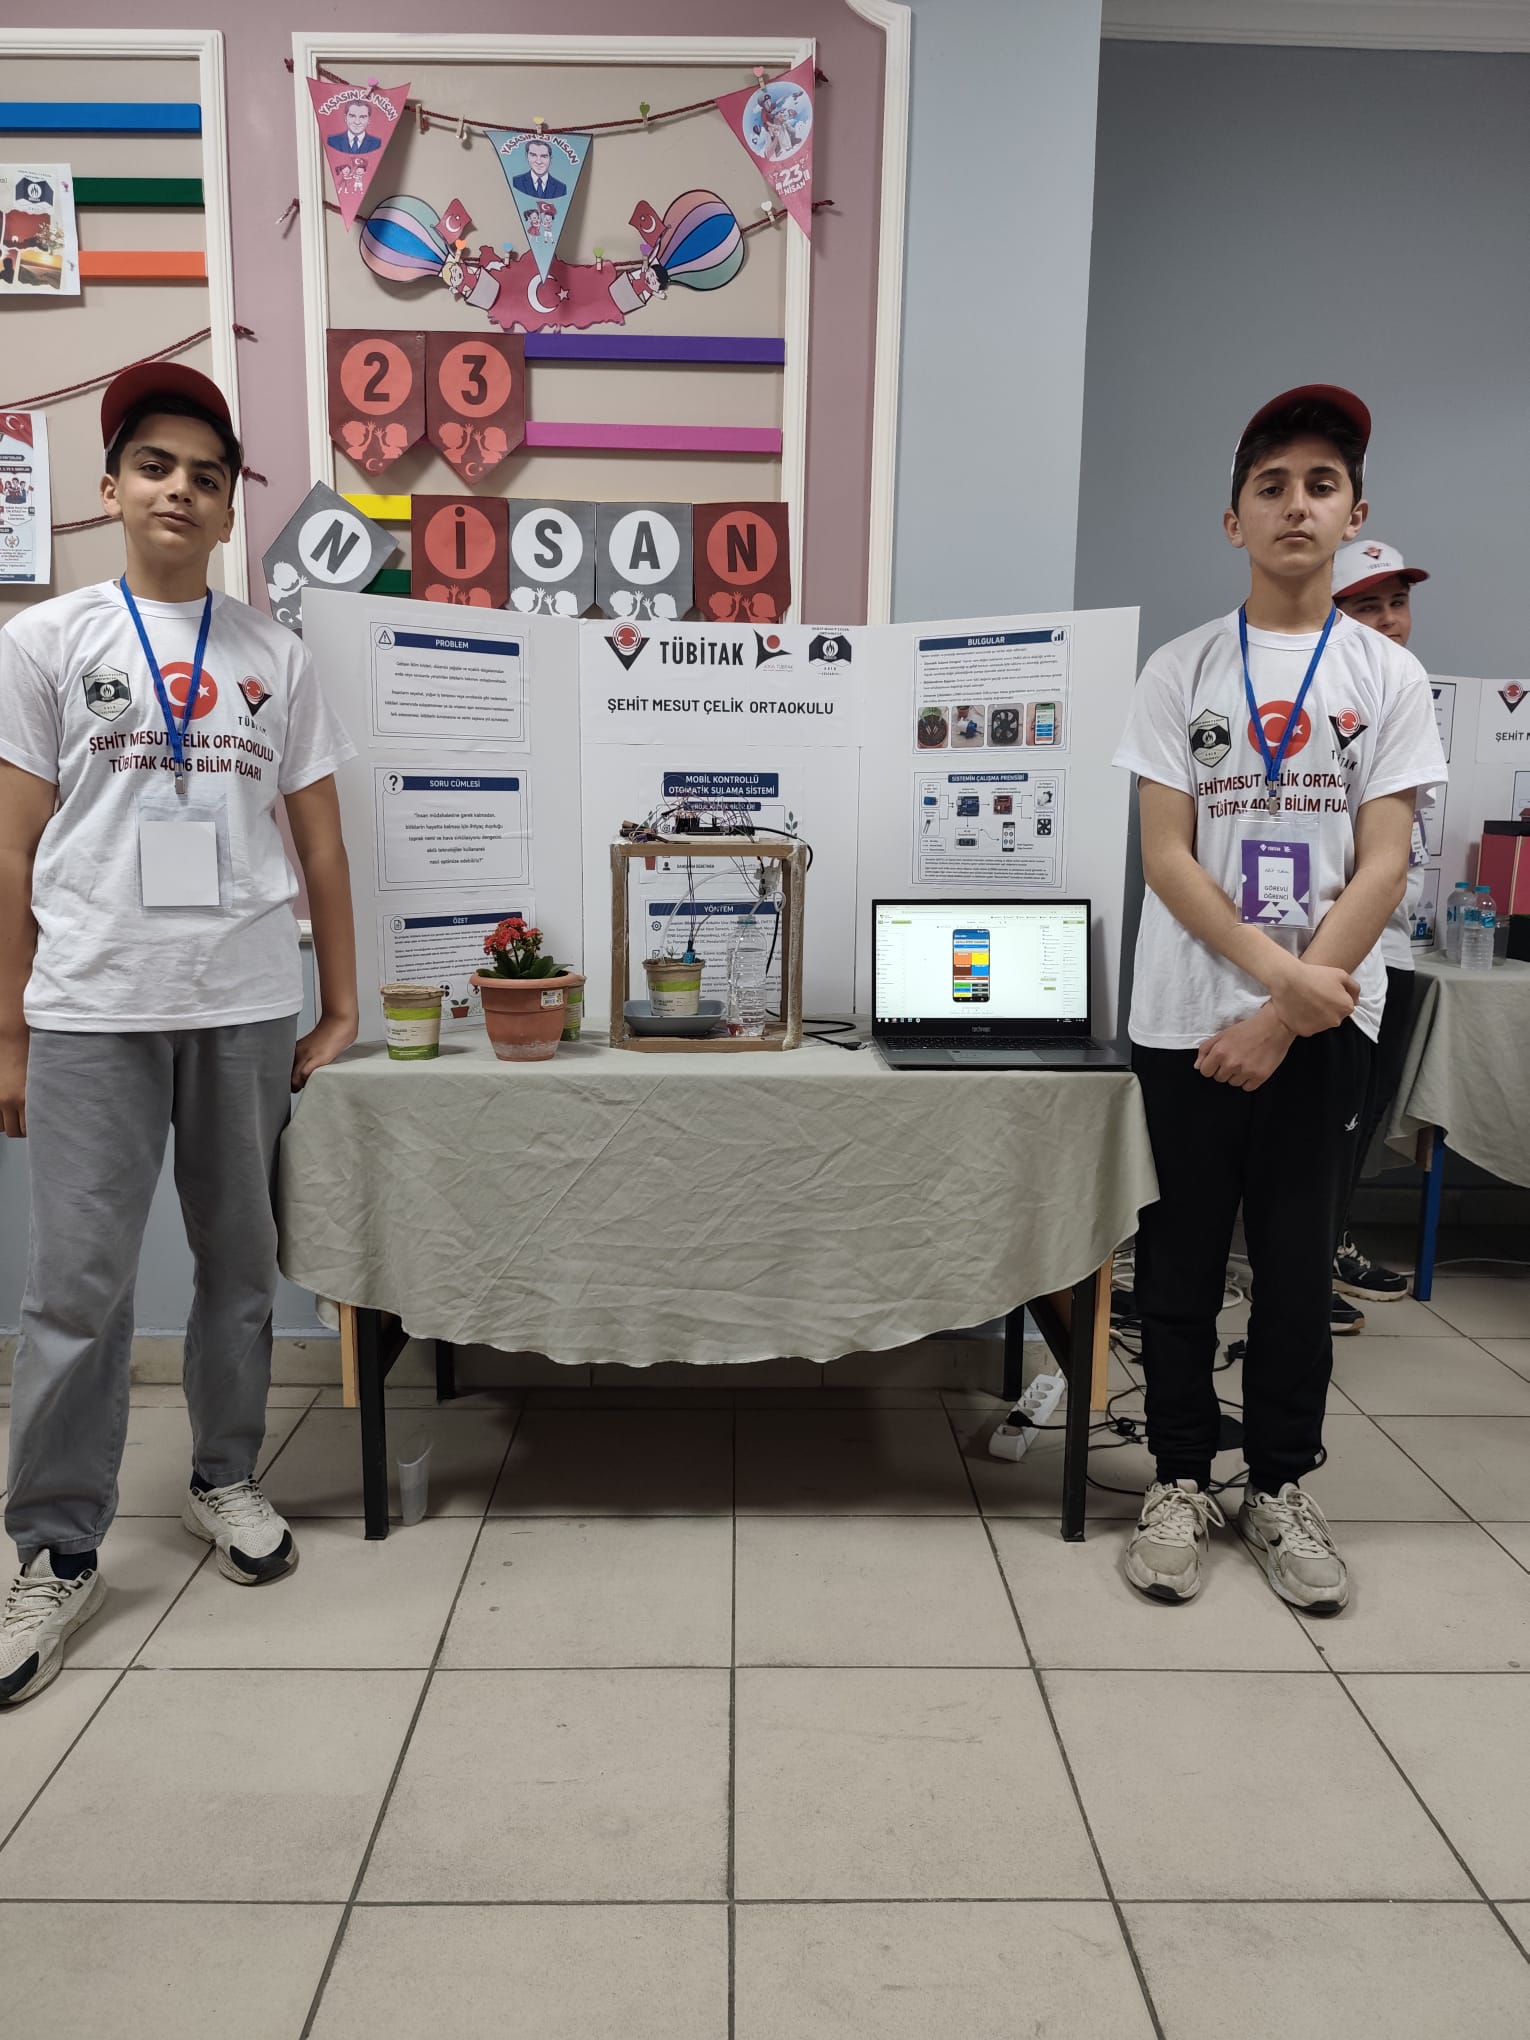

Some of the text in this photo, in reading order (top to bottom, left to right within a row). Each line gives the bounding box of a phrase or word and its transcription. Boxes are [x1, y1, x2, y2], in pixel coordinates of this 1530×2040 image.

[319, 90, 359, 116] YAŞASIN
[374, 95, 398, 121] NİSAN
[537, 133, 551, 143] 23
[552, 138, 580, 165] NİSAN
[780, 164, 803, 187] 23
[783, 180, 806, 196] NİSAN
[435, 639, 469, 649] PROBLEM
[967, 636, 1006, 646] BULGULAR
[660, 637, 744, 666] TÜBİTAK
[607, 697, 834, 715] ŞEHİT MESUT ÇELİK ORTAOKULU
[1495, 730, 1524, 743] ŞEHİT
[90, 731, 126, 755] ŞEHİT
[177, 731, 211, 748] ELİK
[213, 735, 274, 763] ORTAOKULU
[109, 753, 262, 781] TÜBİTAK 406 BİLİM FUARI
[429, 779, 480, 788] SORU CÜMLESİ
[685, 774, 759, 784] MOBİL KONTROLLÜ
[951, 774, 975, 783] SİSTEMİN
[975, 773, 999, 783] ÇALIŞMA
[1198, 777, 1223, 796] EHİT
[668, 785, 775, 795] OTOMATİK SULAMA SİSTEMİ
[1285, 795, 1321, 812] BİLİM
[1325, 799, 1349, 813] FUA
[452, 916, 468, 925] ÖZET
